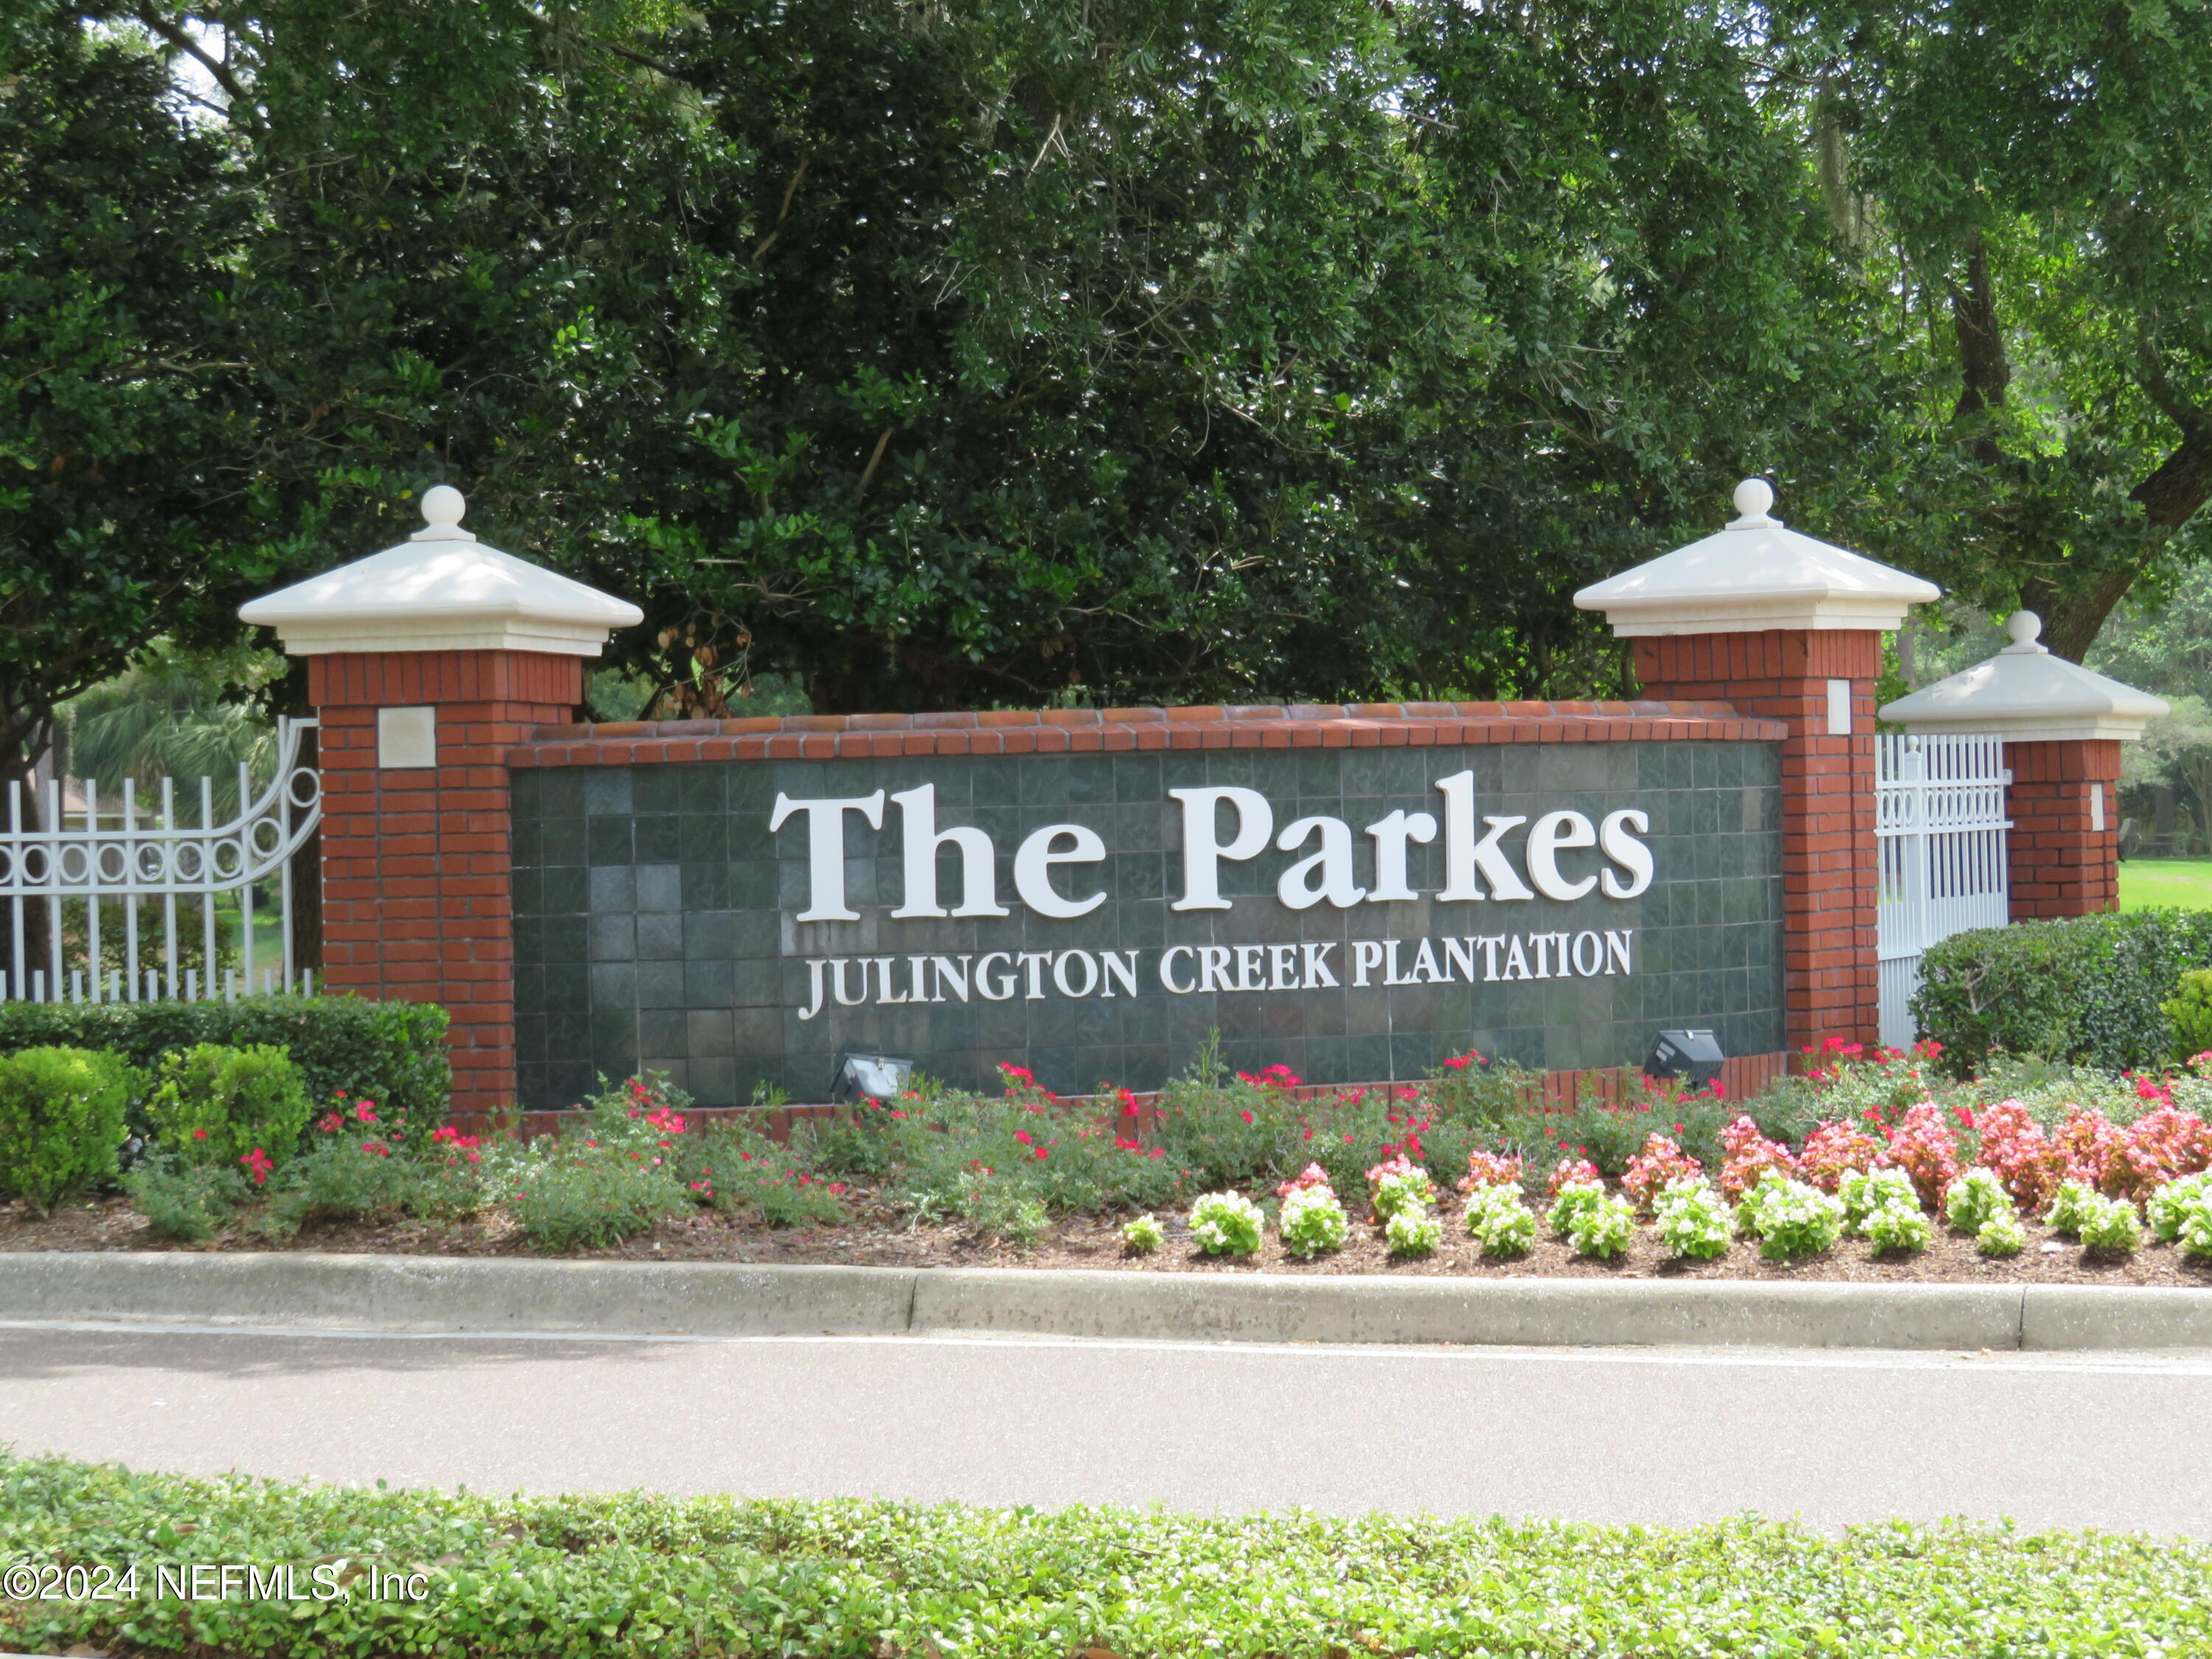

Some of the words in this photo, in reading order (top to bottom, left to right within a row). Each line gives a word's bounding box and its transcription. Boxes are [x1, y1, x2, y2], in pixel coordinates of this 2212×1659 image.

[768, 783, 1107, 922] The
[1168, 770, 1654, 911] Parkes
[798, 948, 1139, 1020] JULINGTON
[1159, 943, 1340, 994] CREEK
[1352, 930, 1632, 988] PLANTATION
